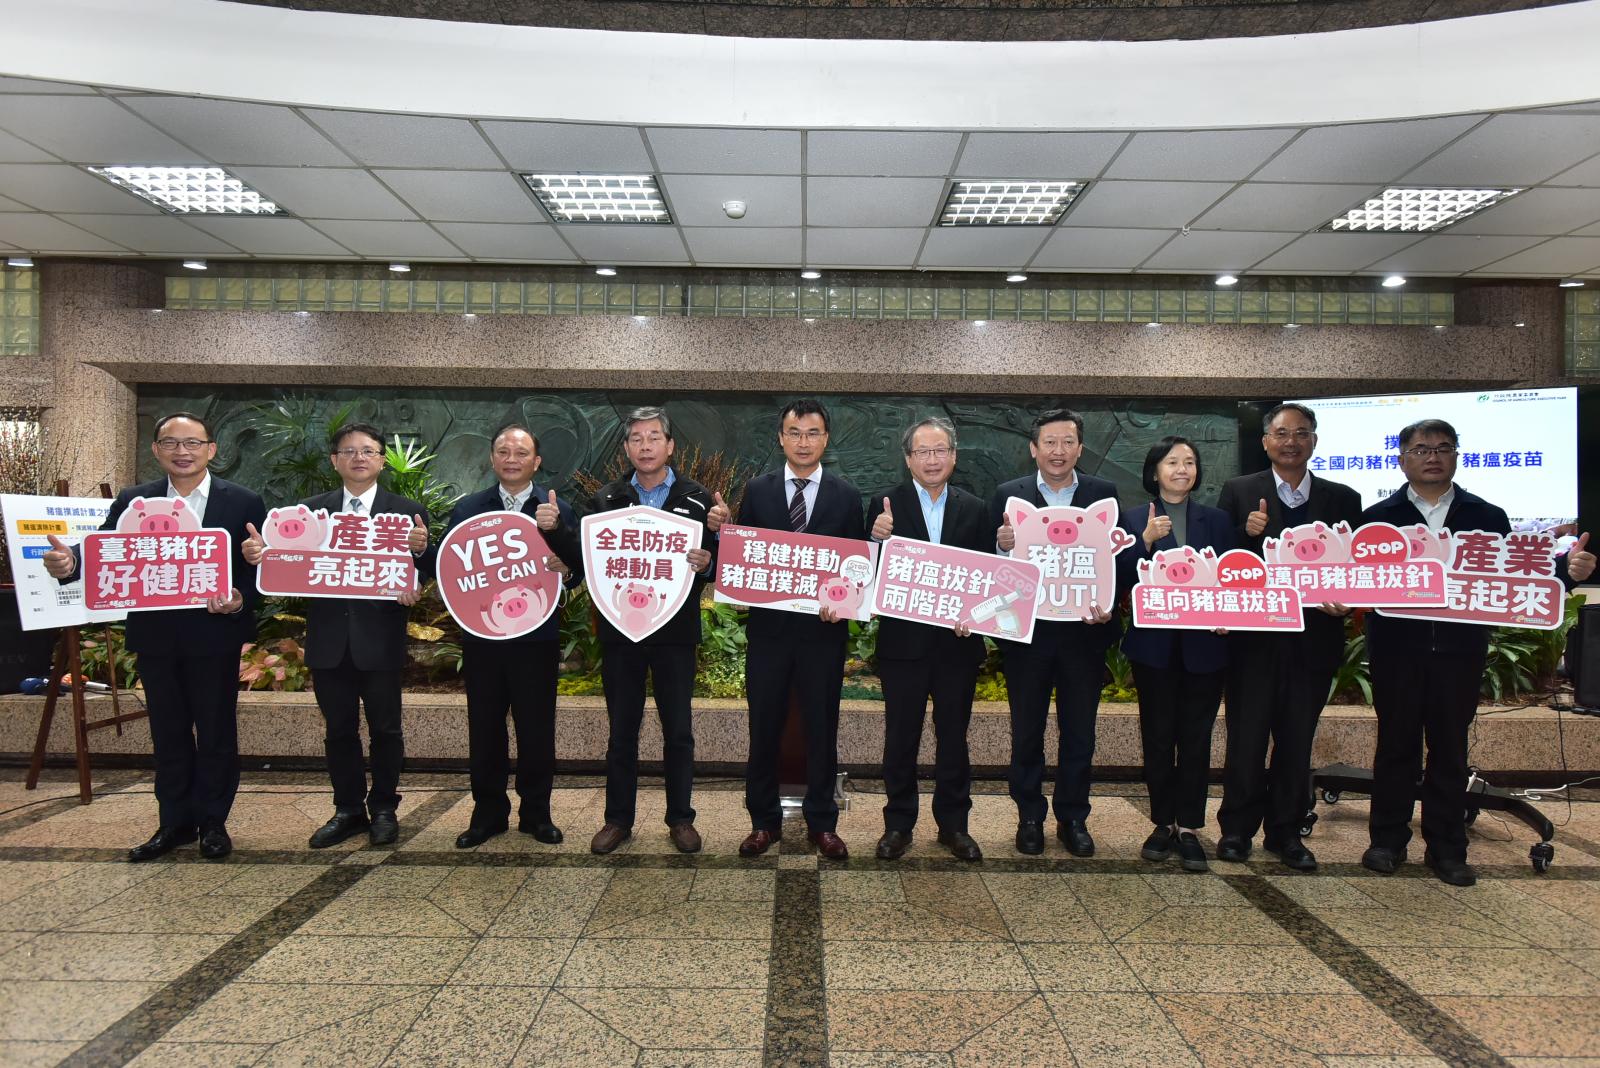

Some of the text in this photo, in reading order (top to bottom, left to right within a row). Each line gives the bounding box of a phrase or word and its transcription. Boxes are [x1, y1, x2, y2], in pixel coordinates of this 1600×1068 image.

[98, 534, 218, 562] 臺灣豬仔
[329, 513, 411, 553] 產業
[450, 528, 529, 573] YES
[595, 527, 689, 554] 全民防疫
[1355, 541, 1404, 558] STOP
[605, 556, 674, 582] 總動員
[742, 539, 841, 574] 穩健推動
[1028, 544, 1097, 579] 豬瘟
[1452, 532, 1555, 577] 產業
[97, 561, 220, 598] 好健康
[308, 555, 408, 590] 亮起來
[457, 572, 489, 594] WE
[496, 560, 537, 584] CAN
[721, 563, 819, 598] 豬瘟撲滅
[886, 554, 997, 598] 豬瘟拔針
[997, 568, 1035, 595] STOP
[1220, 567, 1264, 583] STOP
[1268, 565, 1434, 590] 邁向豬瘟拔針
[882, 583, 965, 622] 兩階段
[1142, 588, 1291, 614] 邁向豬瘟拔針
